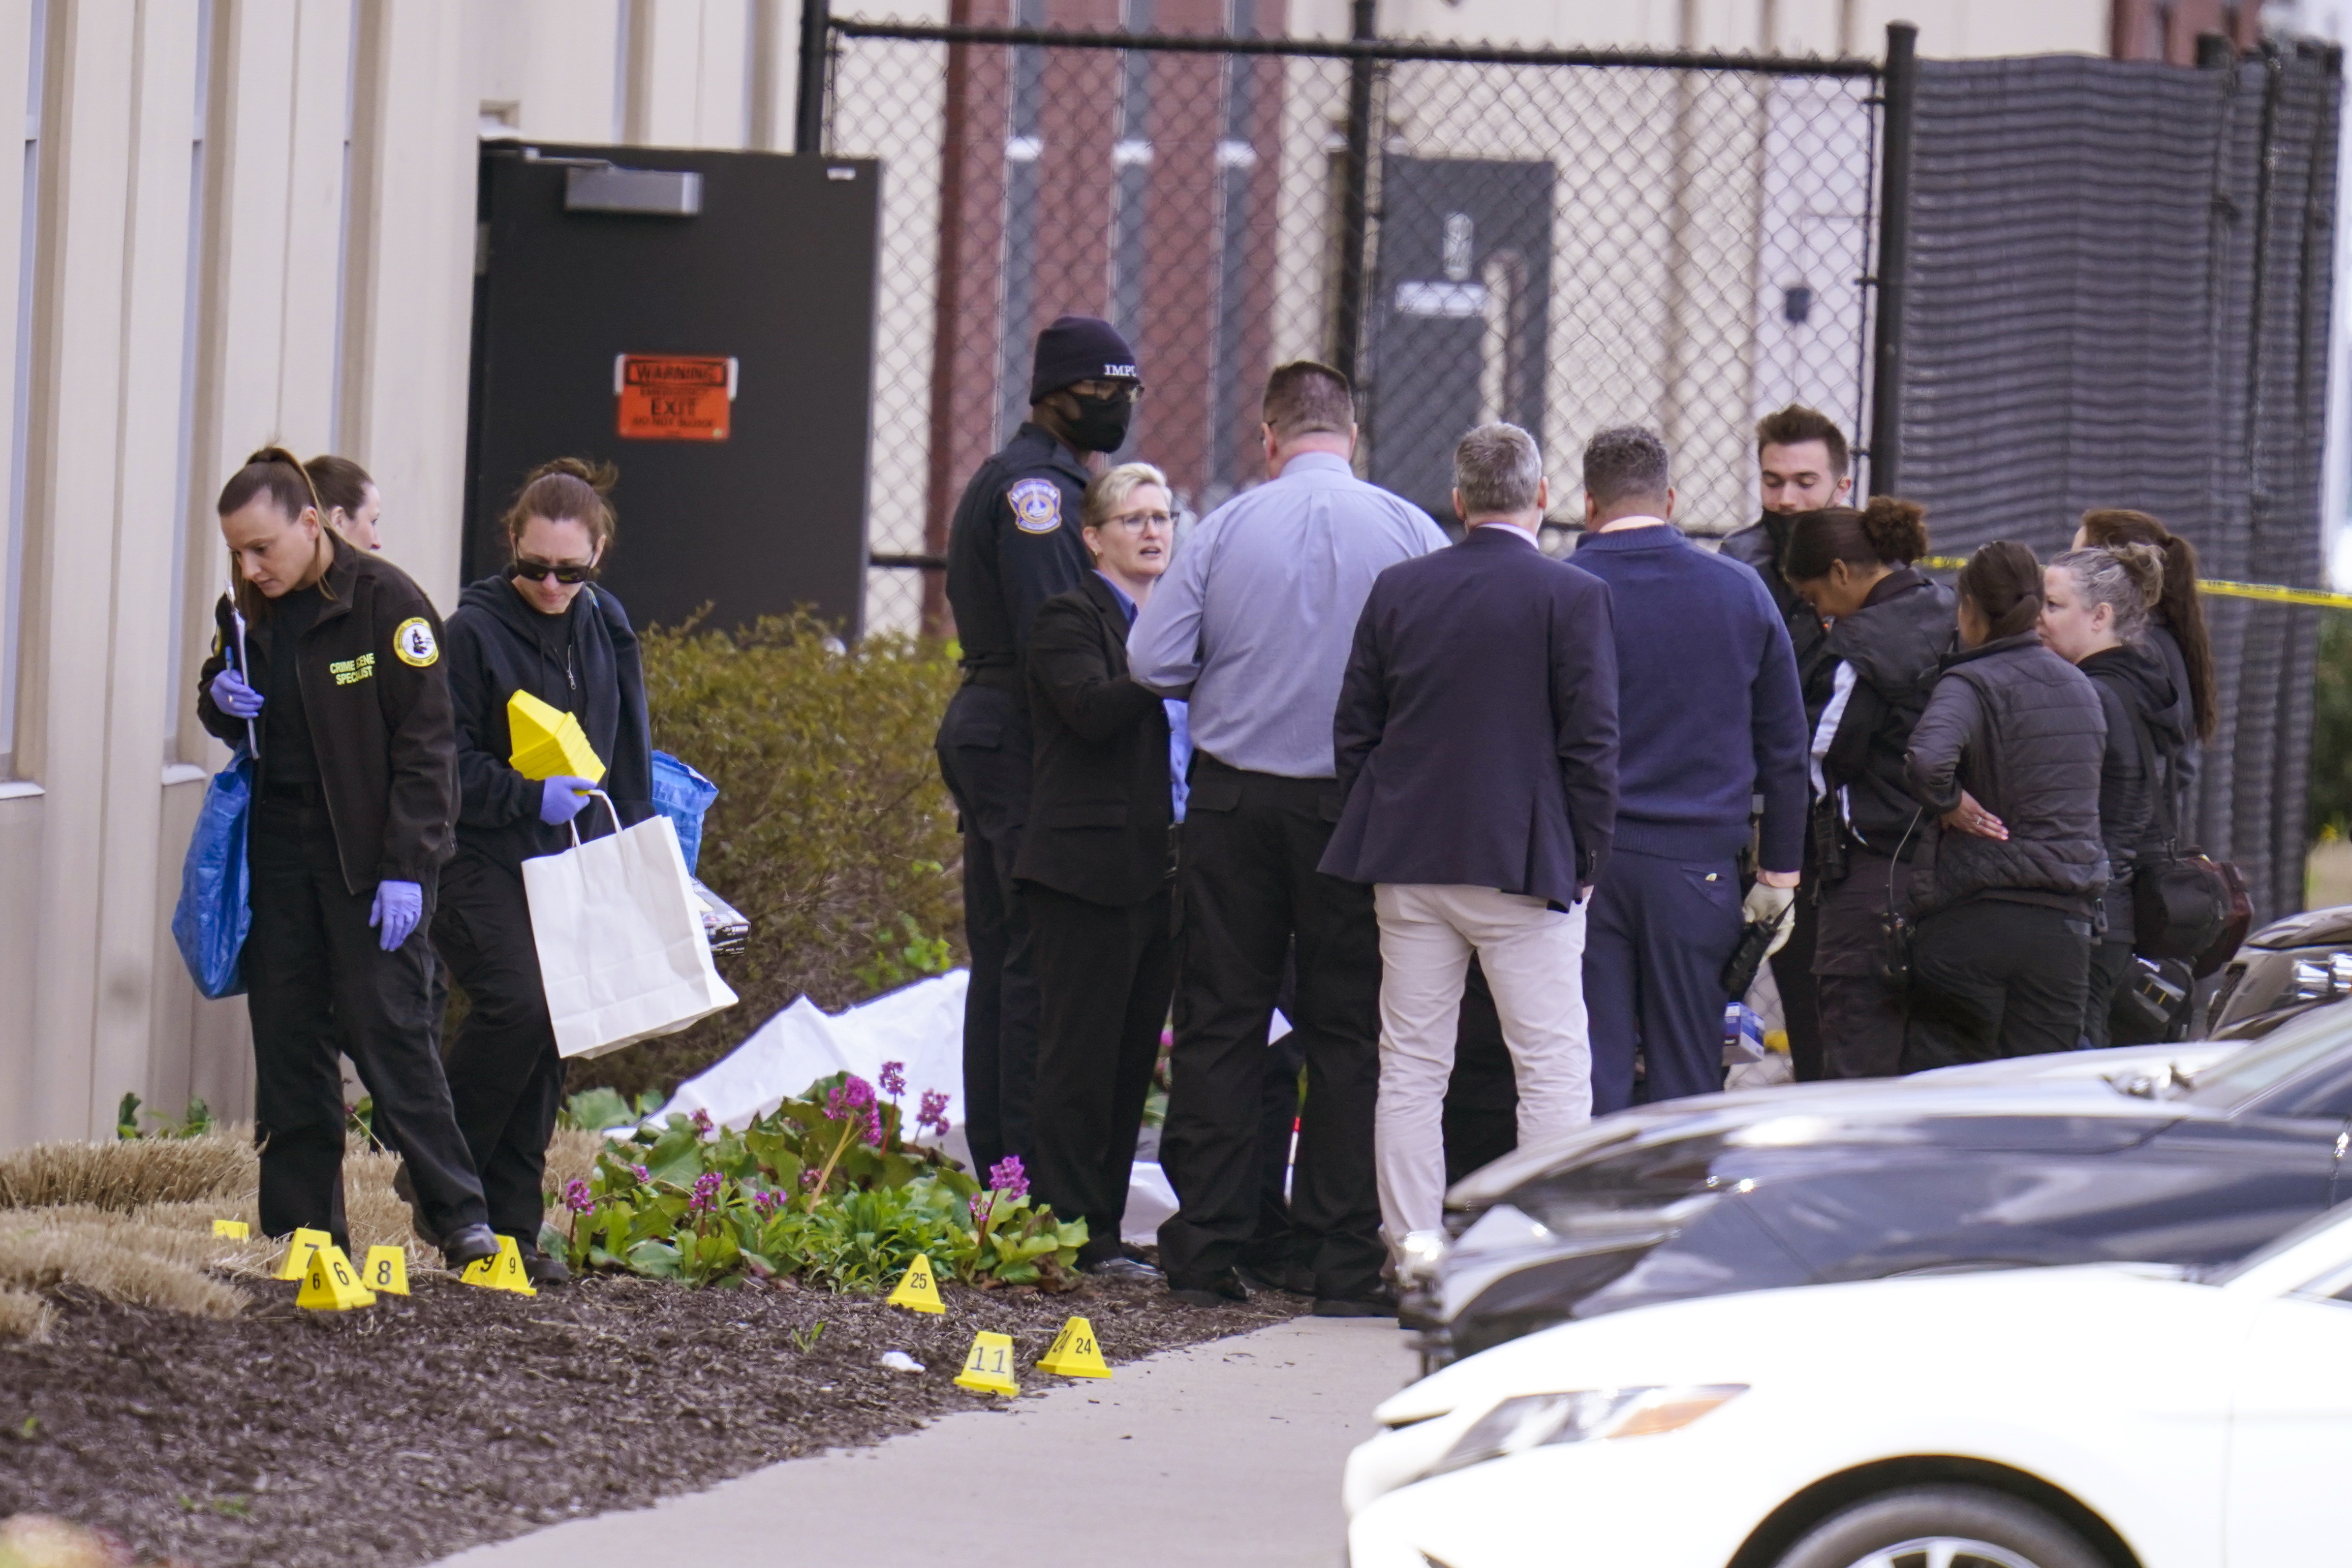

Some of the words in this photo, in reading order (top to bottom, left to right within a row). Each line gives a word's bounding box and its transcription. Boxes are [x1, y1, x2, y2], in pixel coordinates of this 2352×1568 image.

[636, 364, 715, 380] WARNING
[651, 398, 697, 416] EXIT
[330, 660, 356, 674] CRIME
[336, 665, 373, 685] SPECLIST
[304, 1243, 319, 1269] 7
[333, 1262, 349, 1285] 6
[377, 1260, 391, 1285] 8
[509, 1257, 516, 1274] 9
[313, 1273, 320, 1290] 6
[911, 1272, 927, 1289] 25
[1052, 1329, 1072, 1353] 24
[1075, 1337, 1091, 1355] 24
[970, 1346, 1006, 1374] 11
